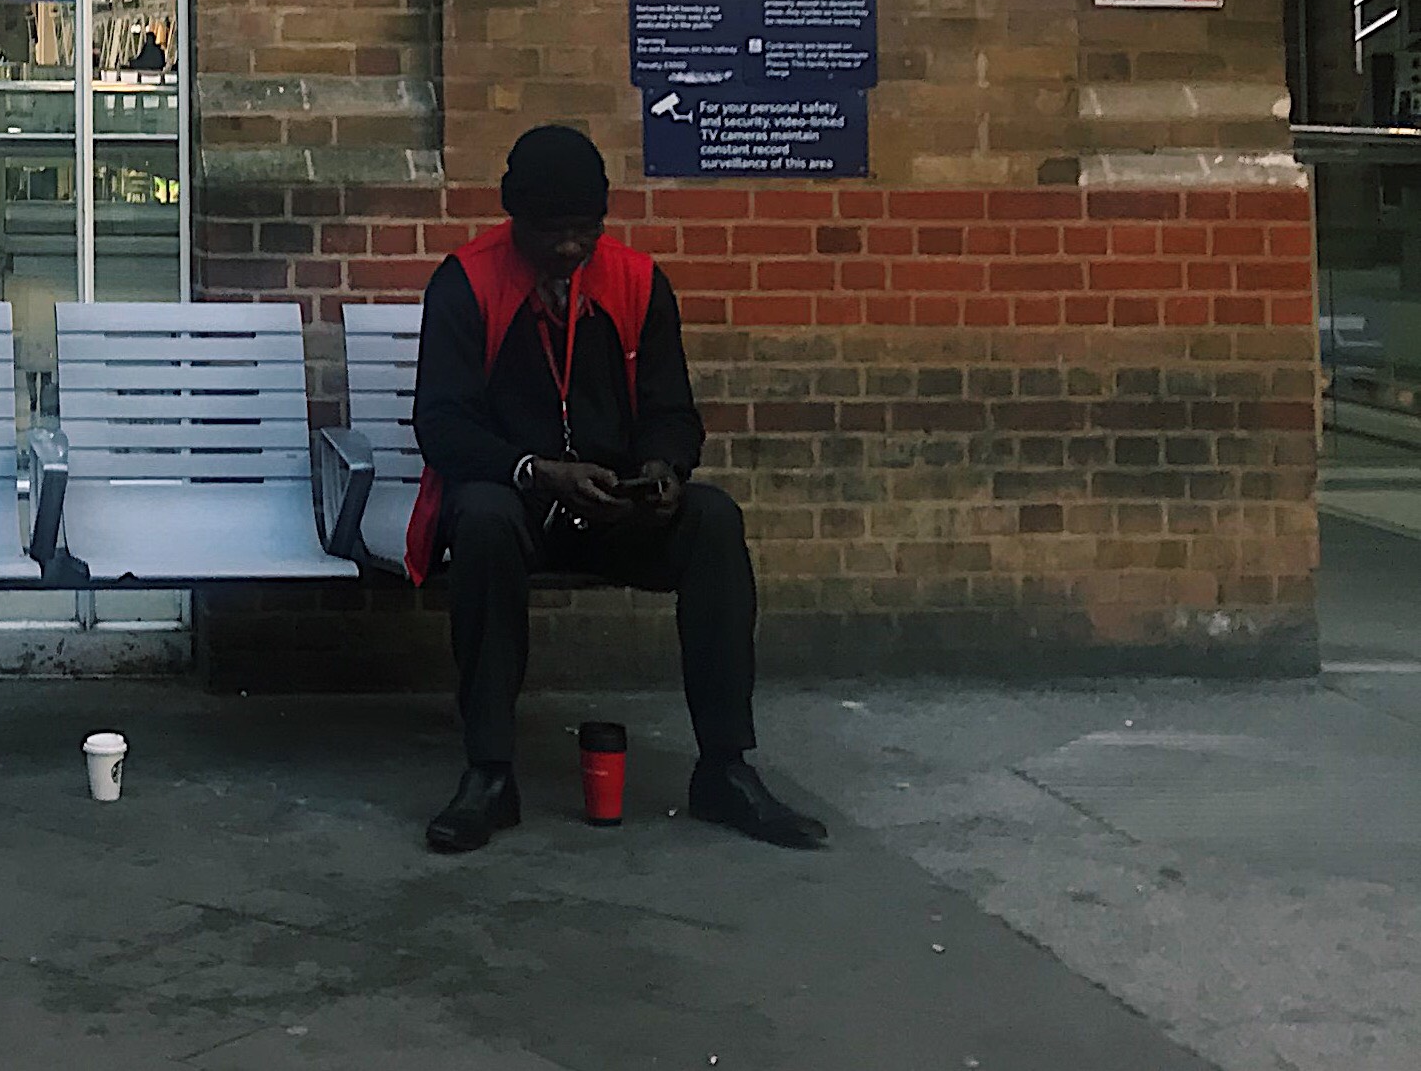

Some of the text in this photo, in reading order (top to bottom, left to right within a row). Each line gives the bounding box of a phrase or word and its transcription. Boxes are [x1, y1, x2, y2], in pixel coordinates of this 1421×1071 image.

[699, 100, 838, 116] For your personal safety
[699, 116, 722, 128] and
[774, 115, 845, 129] video-linked
[700, 129, 820, 142] TV cameras maintain
[700, 143, 790, 156] constant record
[700, 157, 834, 170] surveillance of this area
